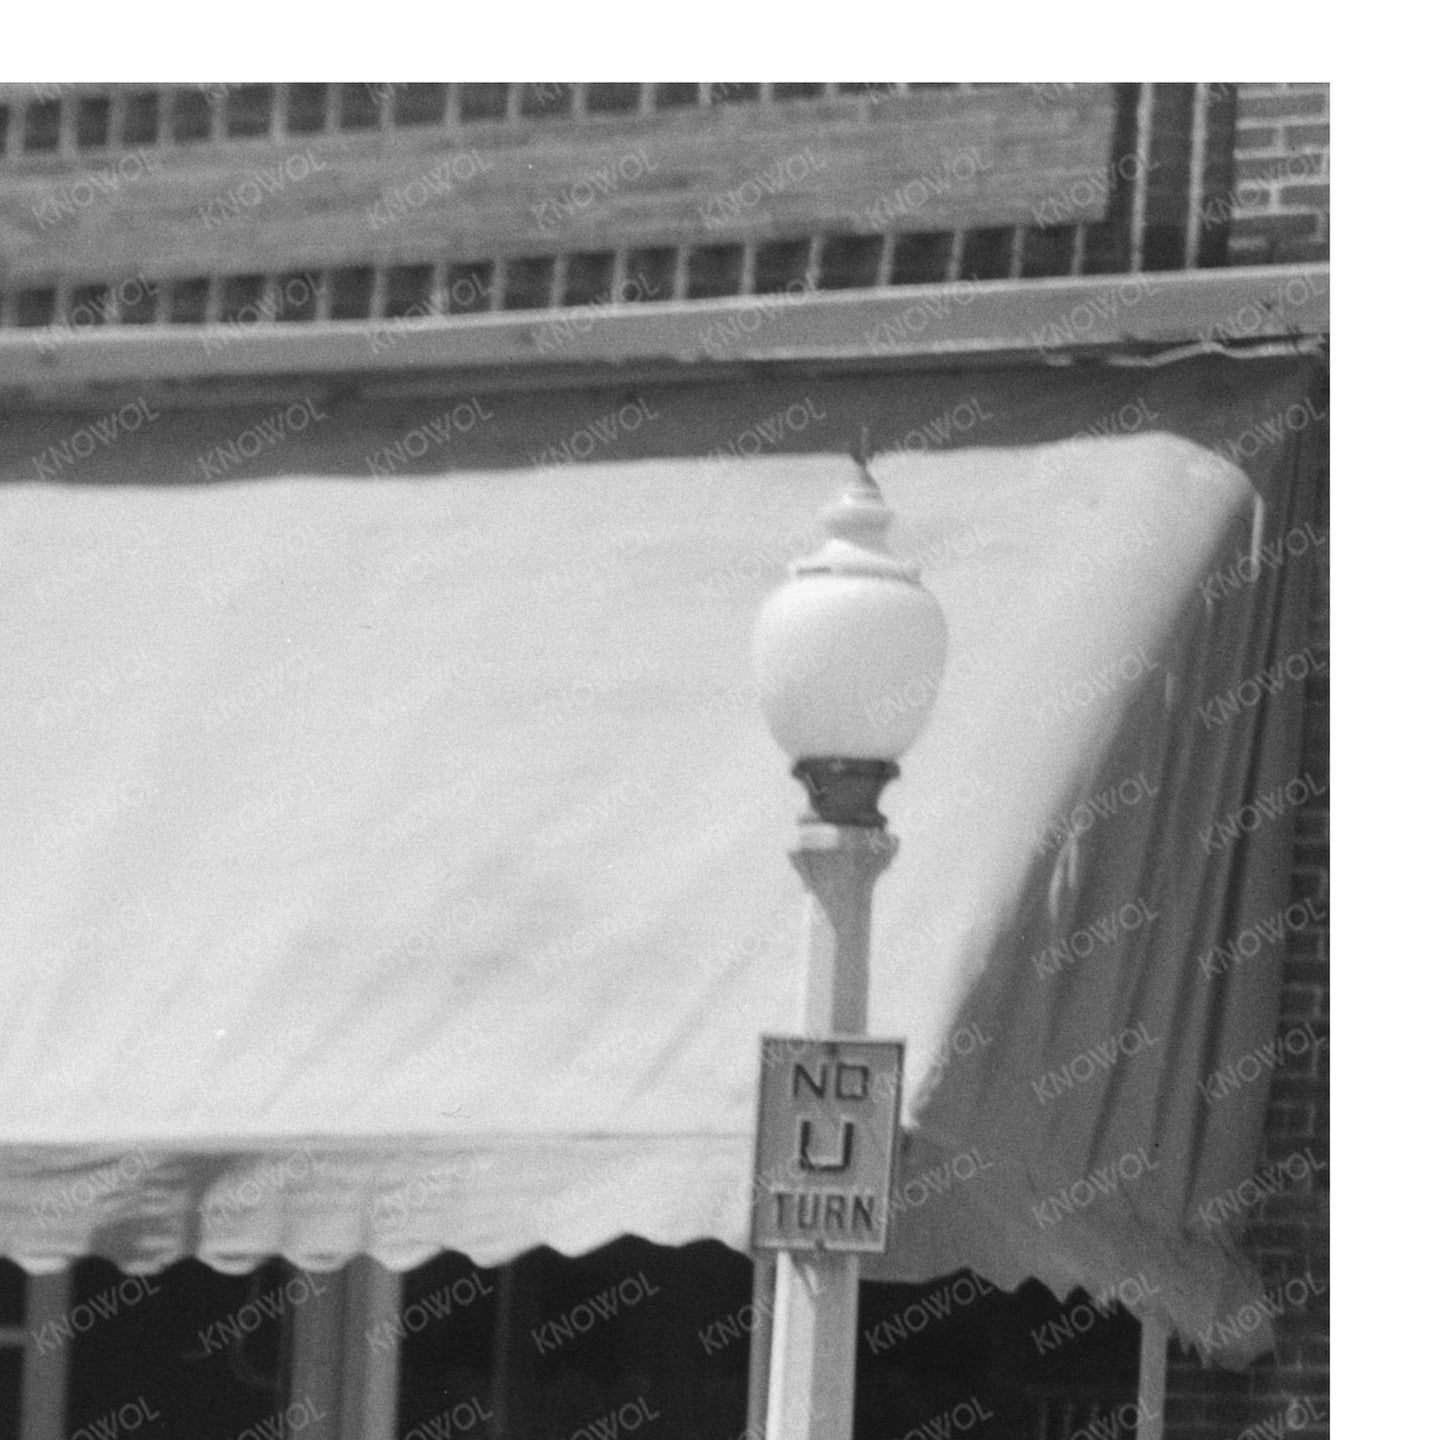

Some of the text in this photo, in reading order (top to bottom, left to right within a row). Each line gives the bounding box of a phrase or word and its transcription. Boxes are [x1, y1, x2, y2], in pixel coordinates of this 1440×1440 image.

[792, 1062, 870, 1100] NO
[798, 1119, 855, 1172] U
[775, 1192, 875, 1230] TURN
